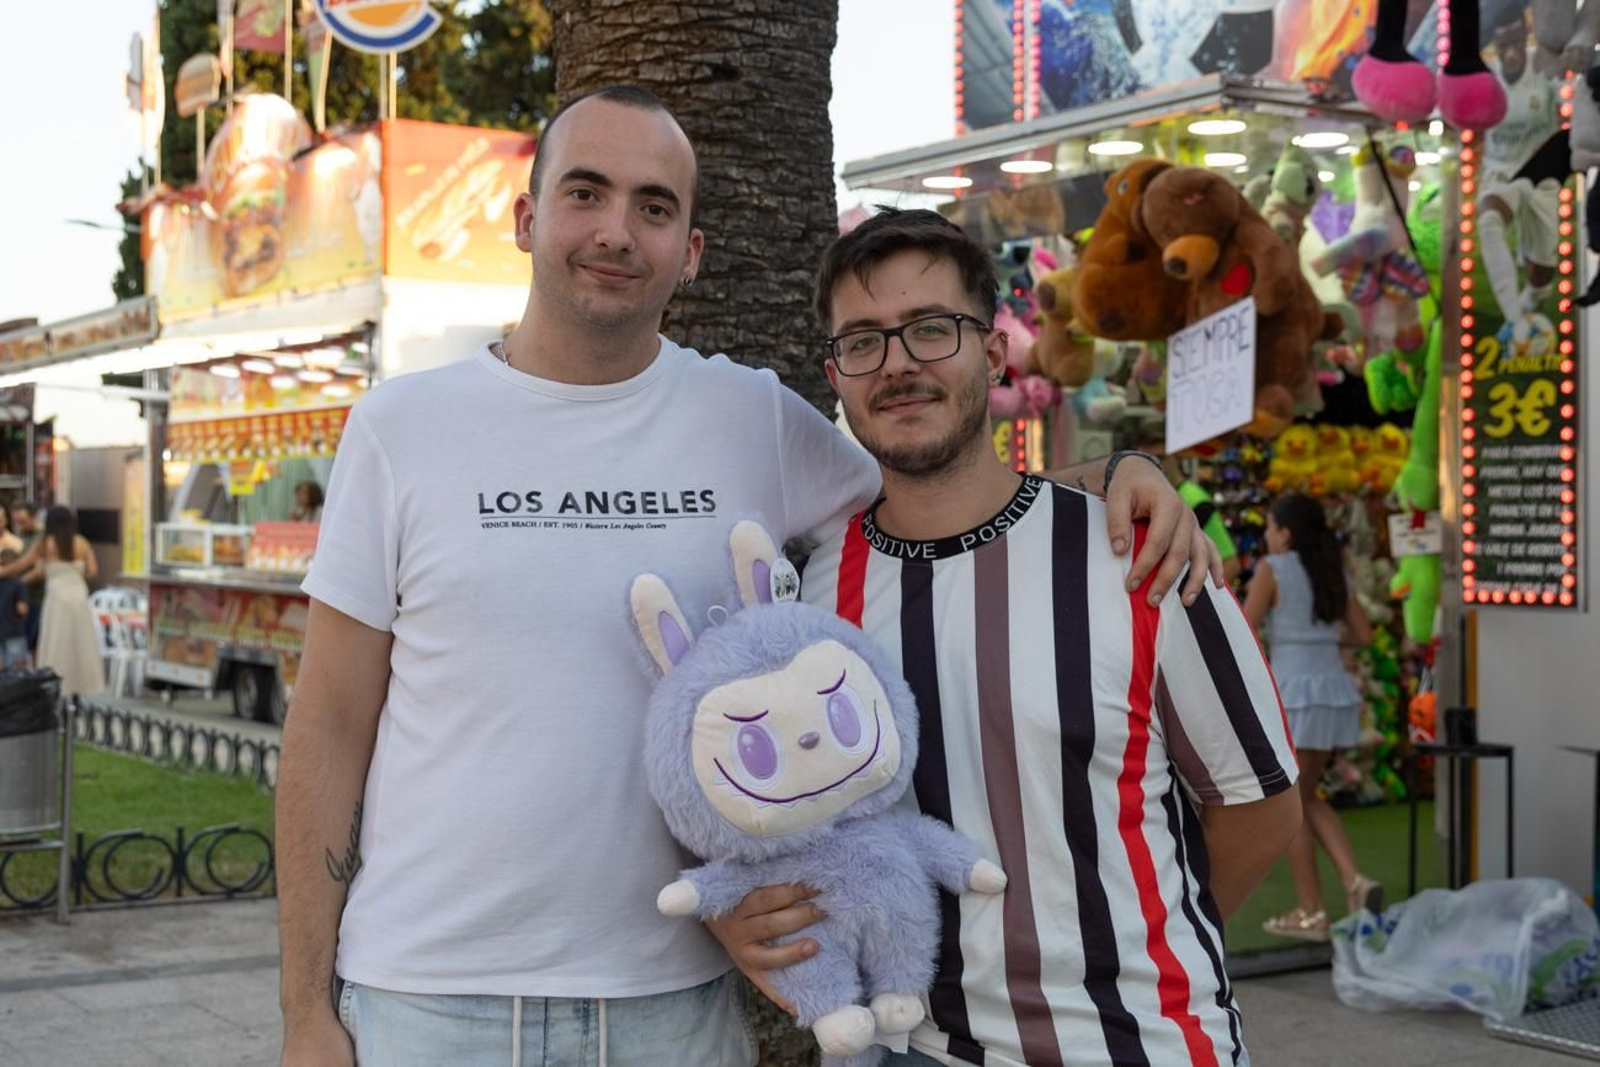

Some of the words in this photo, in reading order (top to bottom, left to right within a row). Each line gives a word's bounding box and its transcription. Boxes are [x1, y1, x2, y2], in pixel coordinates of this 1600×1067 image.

[1171, 305, 1251, 380] SIEMPRE
[1474, 335, 1500, 380] 2
[1482, 378, 1558, 438] 3€
[478, 490, 543, 515] LOS
[558, 489, 716, 515] ANGELES
[481, 521, 509, 529] VENICE
[960, 477, 1042, 551] POSITIVE
[861, 513, 937, 559] POSITIVE
